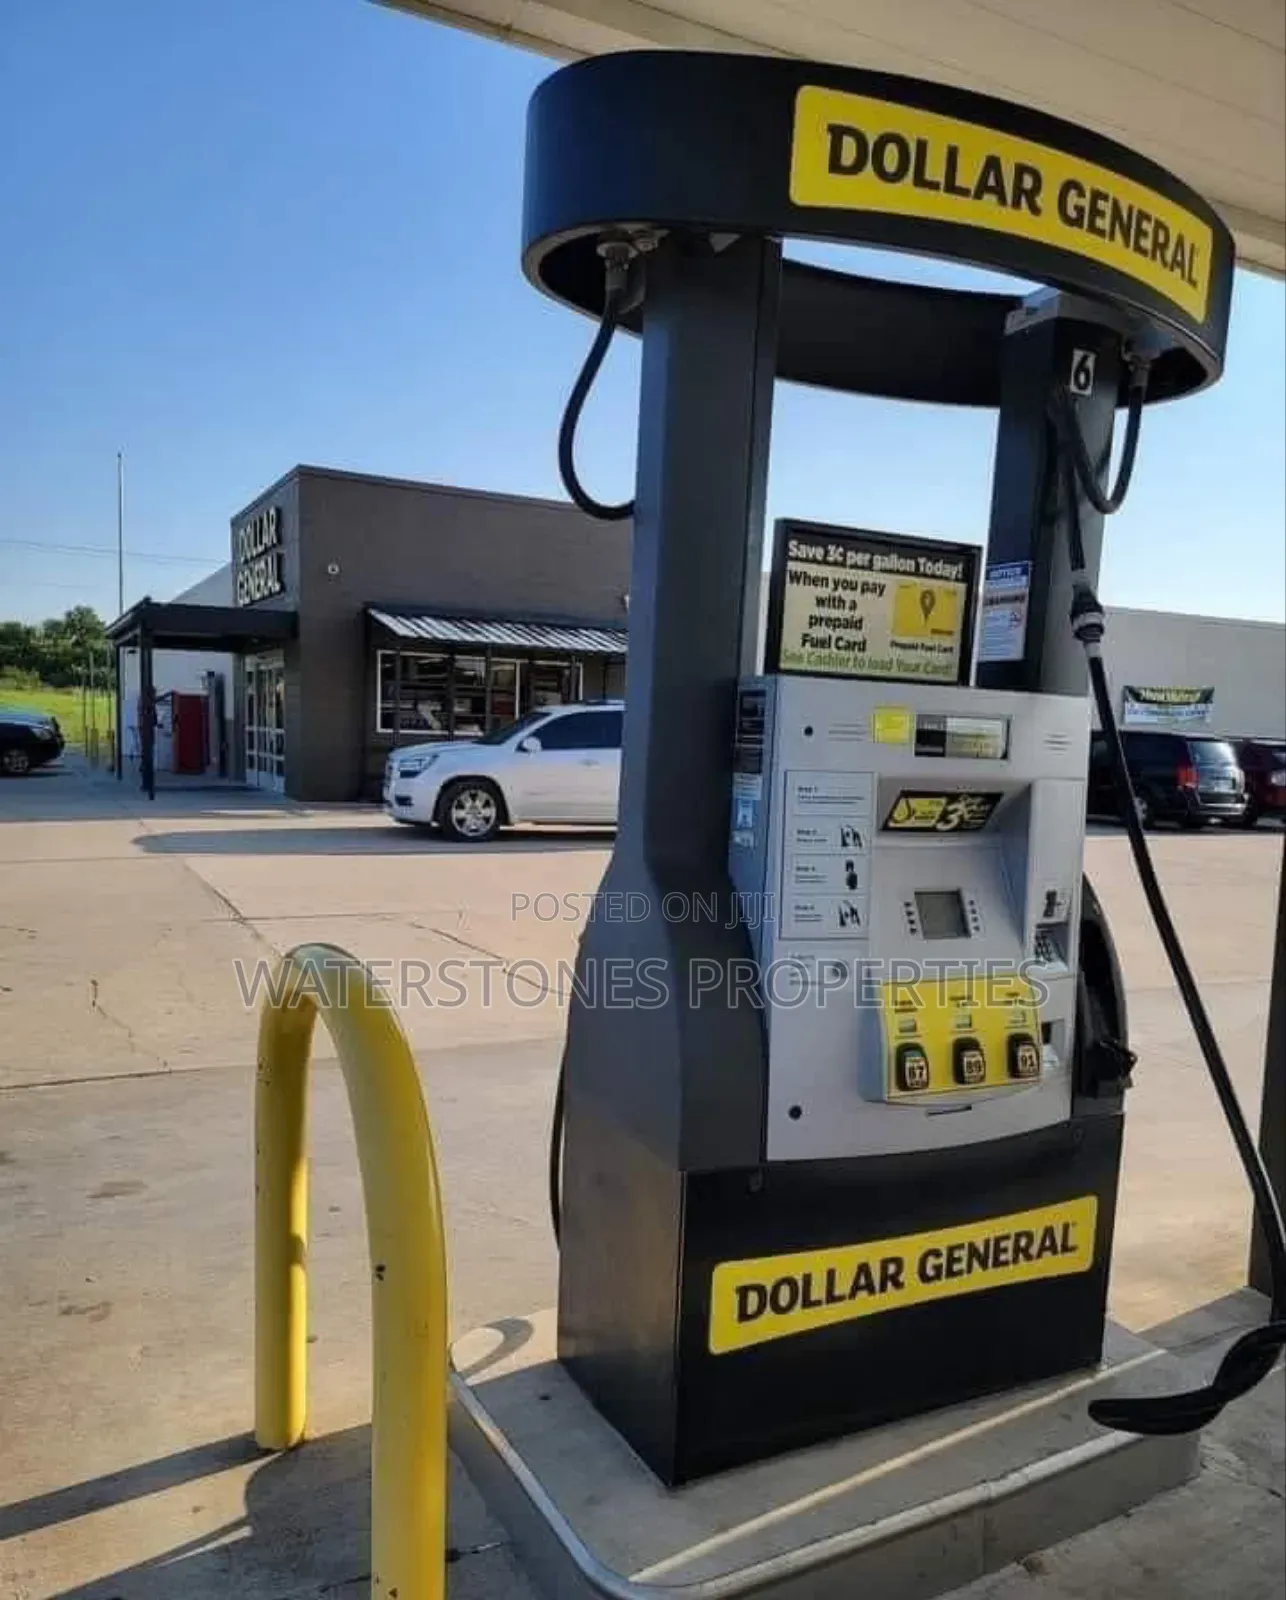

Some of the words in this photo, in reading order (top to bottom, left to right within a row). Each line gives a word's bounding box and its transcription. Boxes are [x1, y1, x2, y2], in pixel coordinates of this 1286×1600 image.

[826, 122, 1043, 217] DOLLAR
[1057, 178, 1199, 289] GENERAL
[1073, 353, 1091, 391] 6
[788, 540, 825, 560] Save
[846, 550, 871, 569] per
[872, 554, 916, 574] gallon
[917, 557, 963, 580] Today!
[788, 570, 829, 588] When
[832, 576, 858, 591] you
[860, 581, 886, 597] pay
[815, 594, 846, 611] with
[848, 599, 858, 612] a
[807, 614, 864, 631] prepaid
[801, 632, 832, 650] Fuel
[835, 635, 867, 653] Card
[735, 1256, 905, 1323] DOLLAR
[917, 1222, 1078, 1284] GENERAL
